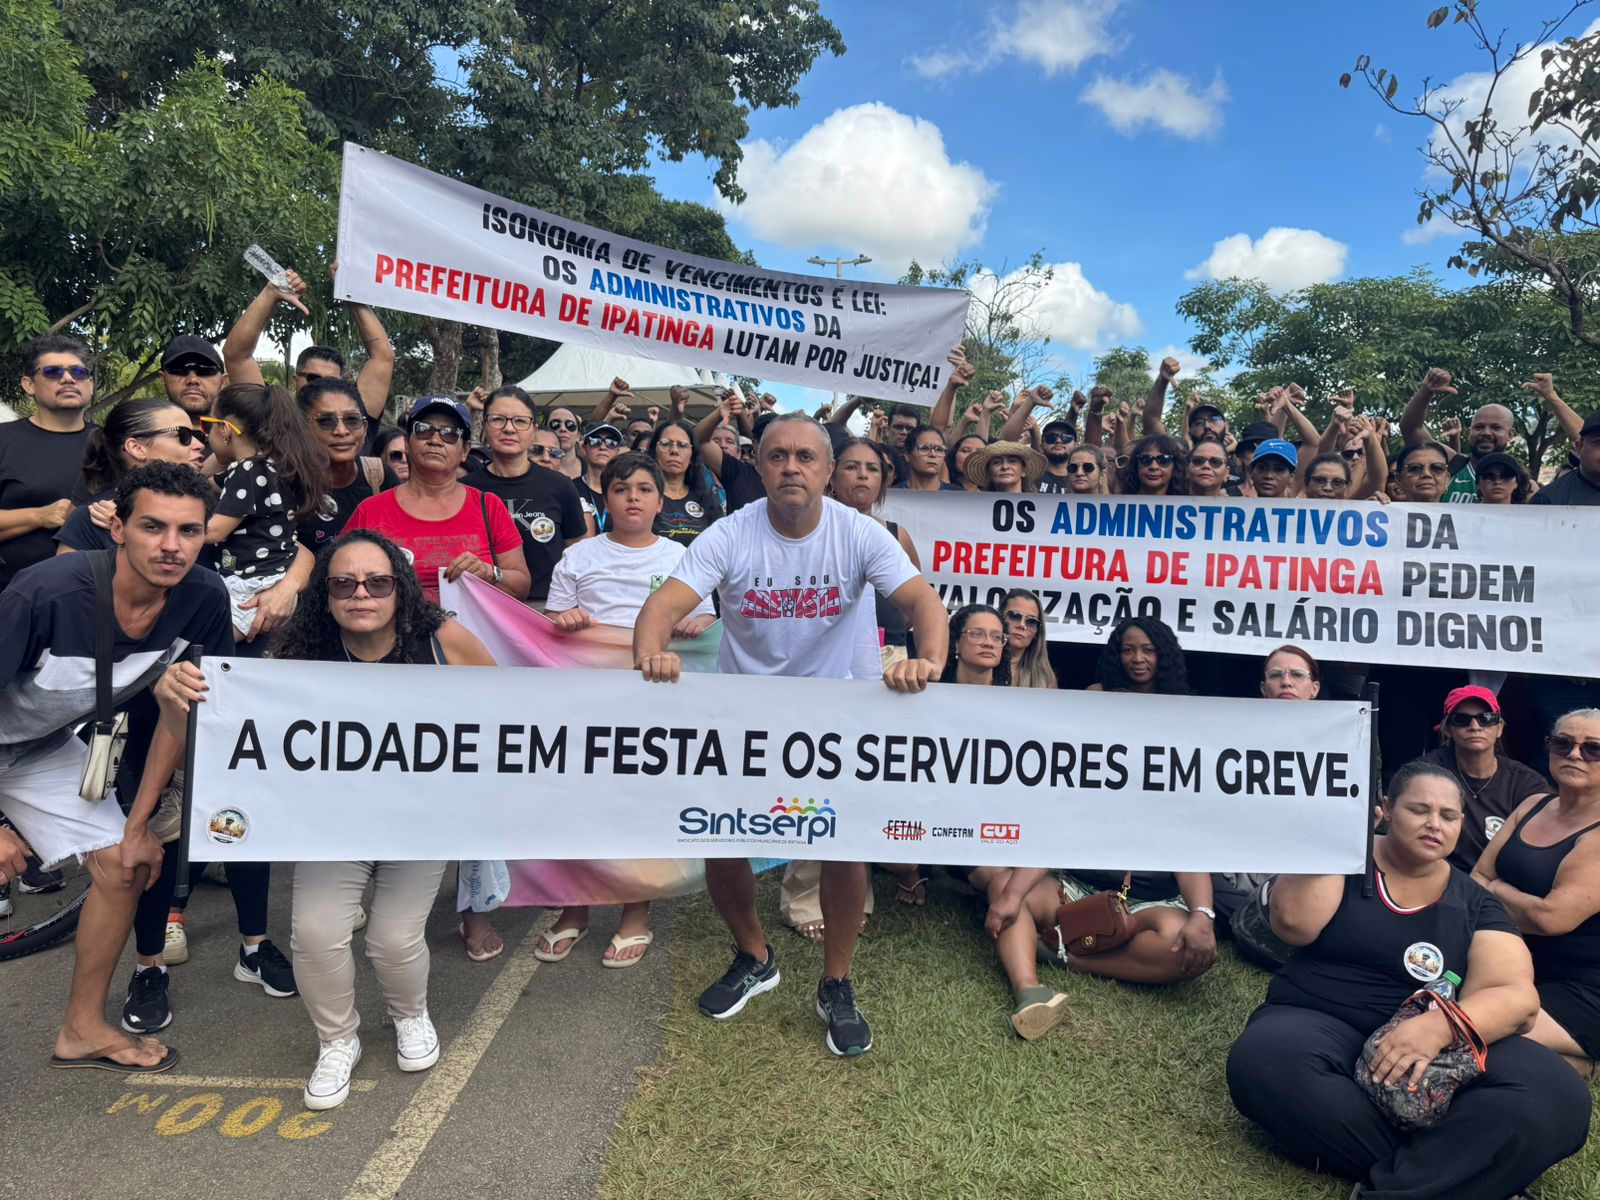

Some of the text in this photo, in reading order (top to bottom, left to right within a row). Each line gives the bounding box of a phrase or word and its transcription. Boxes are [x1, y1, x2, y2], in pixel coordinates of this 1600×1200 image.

[482, 203, 887, 316] ISONOMIA DE VENCIMENTOS É LEI:
[375, 254, 941, 392] PREFEITURA DE IPATINGA LUTAM POR JUSTIÇA!
[543, 254, 841, 340] OS ADMINISTRATIVOS DA
[992, 499, 1459, 550] OS ADMINISTRATIVOS DA
[754, 574, 830, 587] EU SOU
[932, 540, 1535, 603] PREFEITURA DE IPATINGA PEDEM
[929, 582, 1543, 653] VALOZAÇÃO E SALÁRIO DIGNO!
[227, 718, 1360, 798] A CIDADE EM FESTA E OS SERVIDORES EM GREVE.
[678, 806, 837, 845] Sintserpi
[887, 820, 922, 841] FETAM
[982, 824, 1019, 838] CUT
